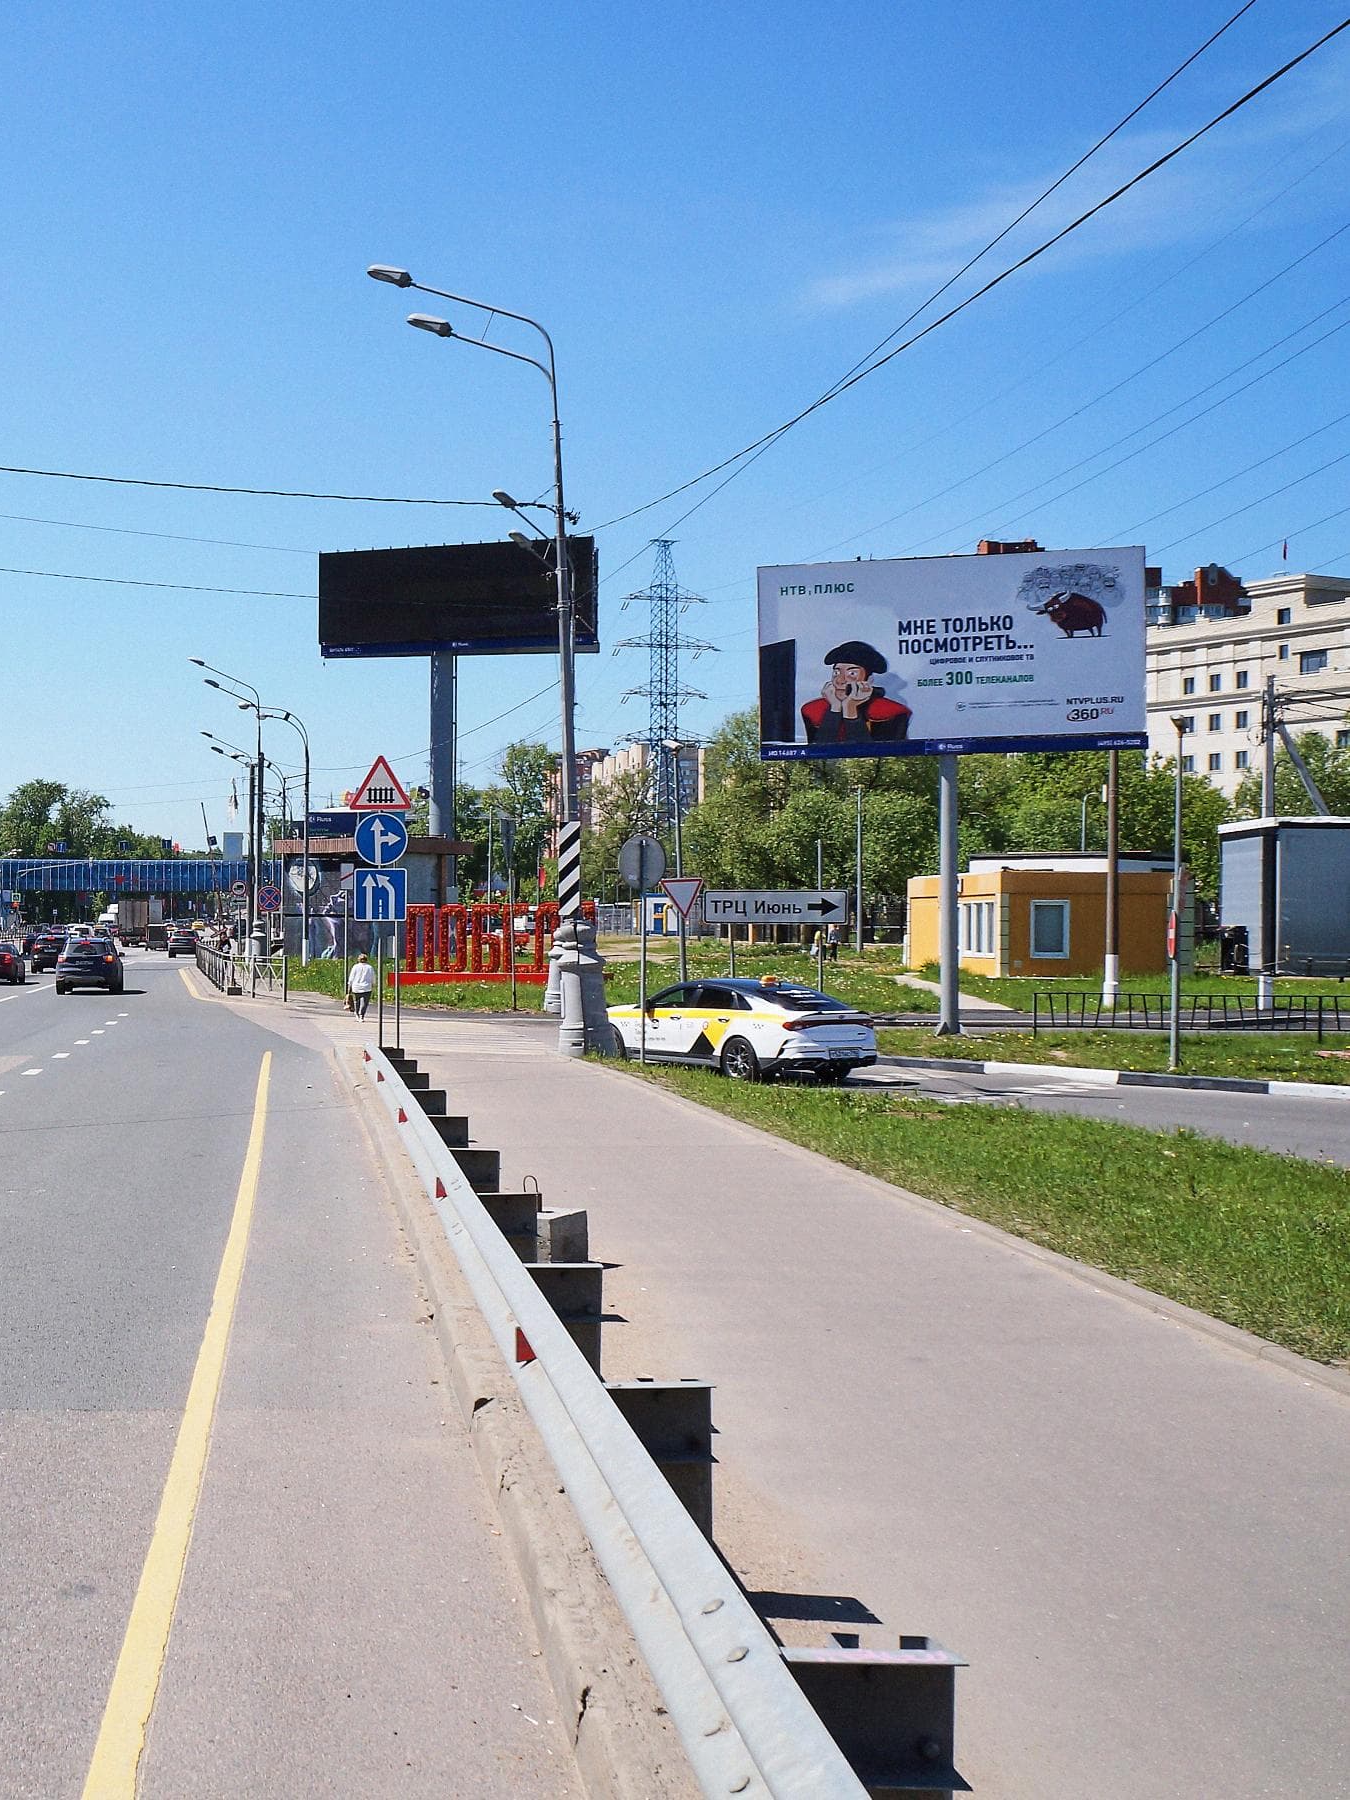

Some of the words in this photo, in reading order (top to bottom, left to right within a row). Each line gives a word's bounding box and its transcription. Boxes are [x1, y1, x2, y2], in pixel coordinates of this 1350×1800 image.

[814, 583, 855, 594] ПЛЮС
[898, 619, 937, 636] МНЕ
[941, 615, 1014, 634] ТОЛЬКО
[898, 634, 1035, 655] ПОСМОТРЕТЬ...
[930, 656, 966, 665] ЦИФРОВОЕ
[975, 654, 1024, 663] СПУТНИКОВОЕ
[917, 678, 943, 687] БОЛЕЕ
[945, 671, 973, 686] 300
[976, 674, 1035, 684] ТЕЛЕКАНАЛОВ
[1066, 696, 1124, 705] NTVPLUS.RU
[711, 900, 747, 917] ТРЦ
[754, 900, 802, 915] Июнь
[406, 901, 597, 973] ПОБЕД
